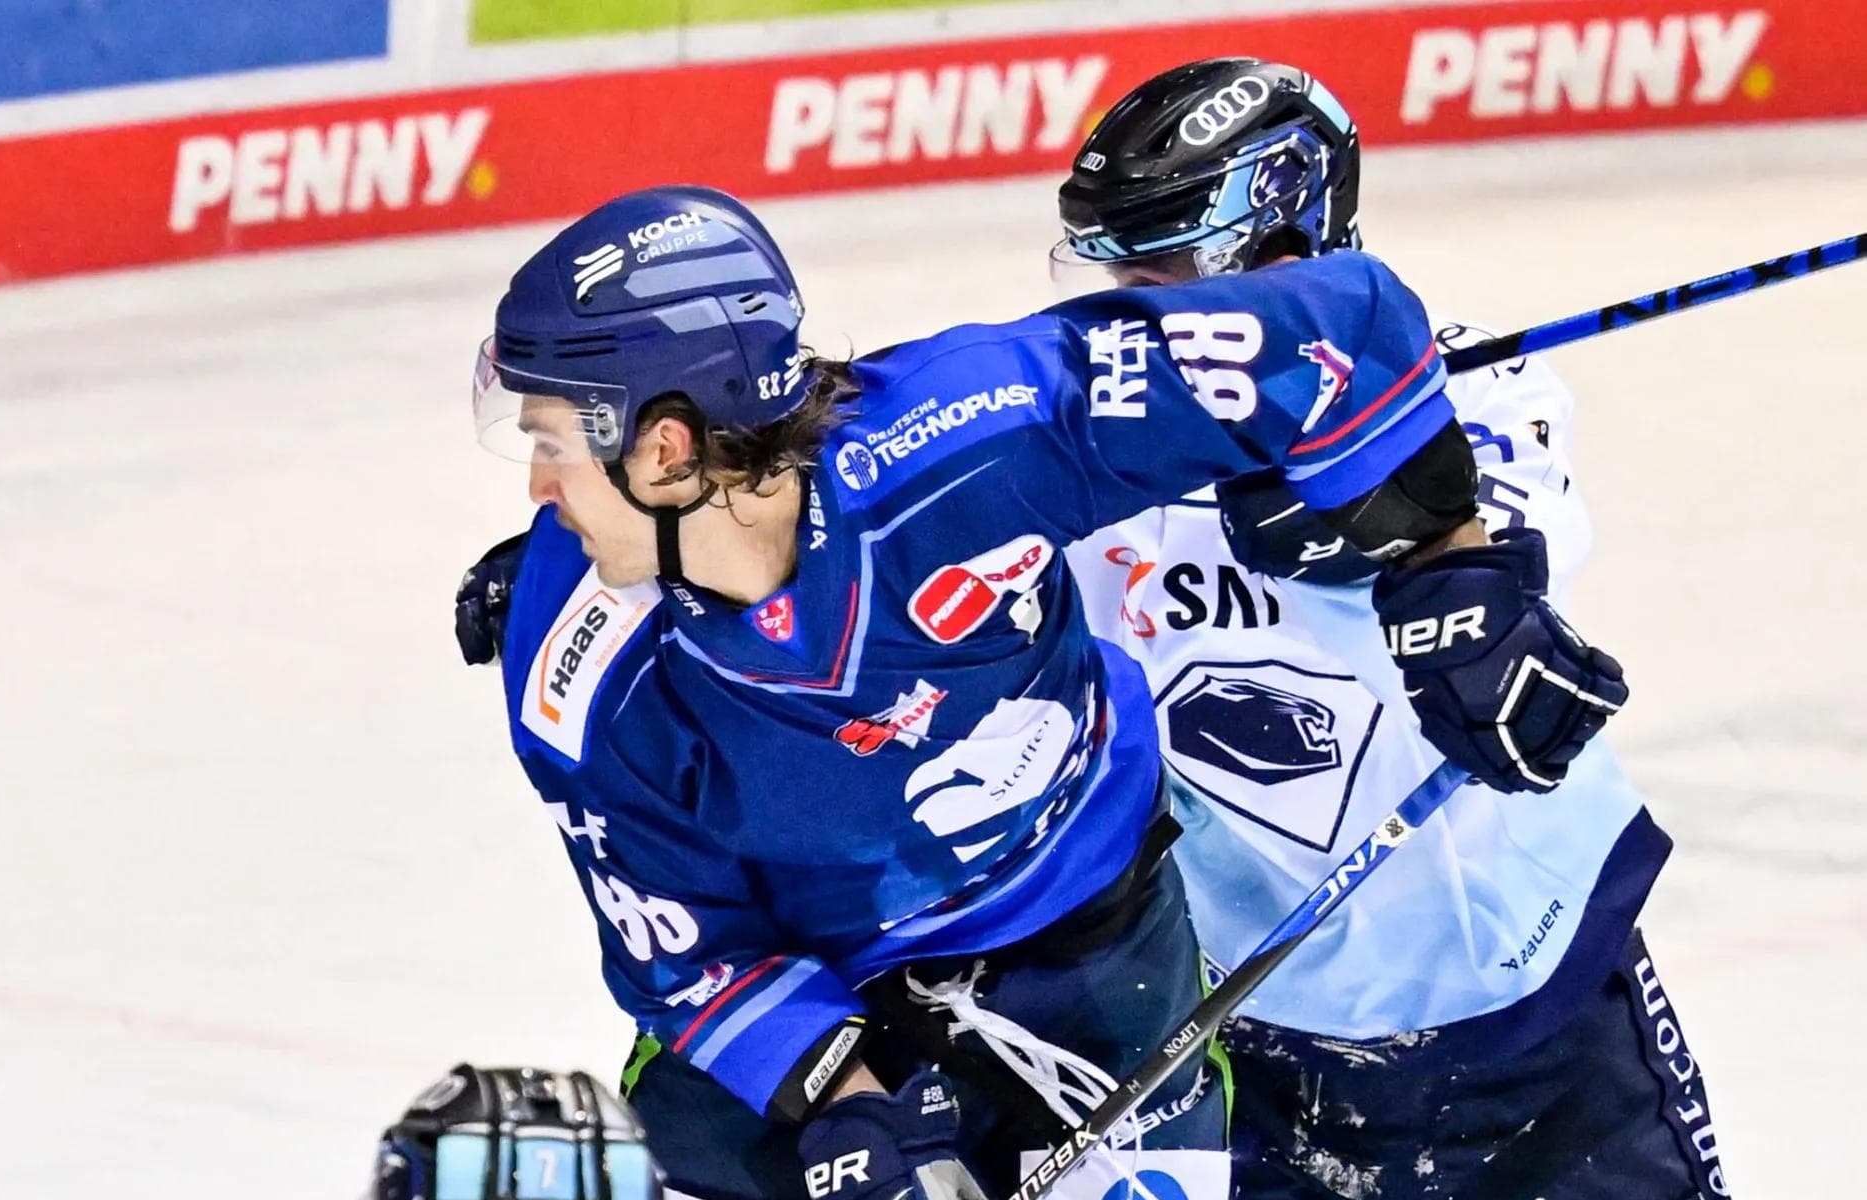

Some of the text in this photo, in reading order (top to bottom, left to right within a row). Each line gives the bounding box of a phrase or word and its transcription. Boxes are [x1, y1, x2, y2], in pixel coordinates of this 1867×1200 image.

[628, 211, 703, 249] KOCH
[636, 230, 708, 264] GRUPPE
[757, 371, 781, 400] 88
[866, 396, 939, 446] DEUTSCHE
[873, 384, 1039, 467] TECHNOPLAST
[1163, 1020, 1201, 1058] LIPON
